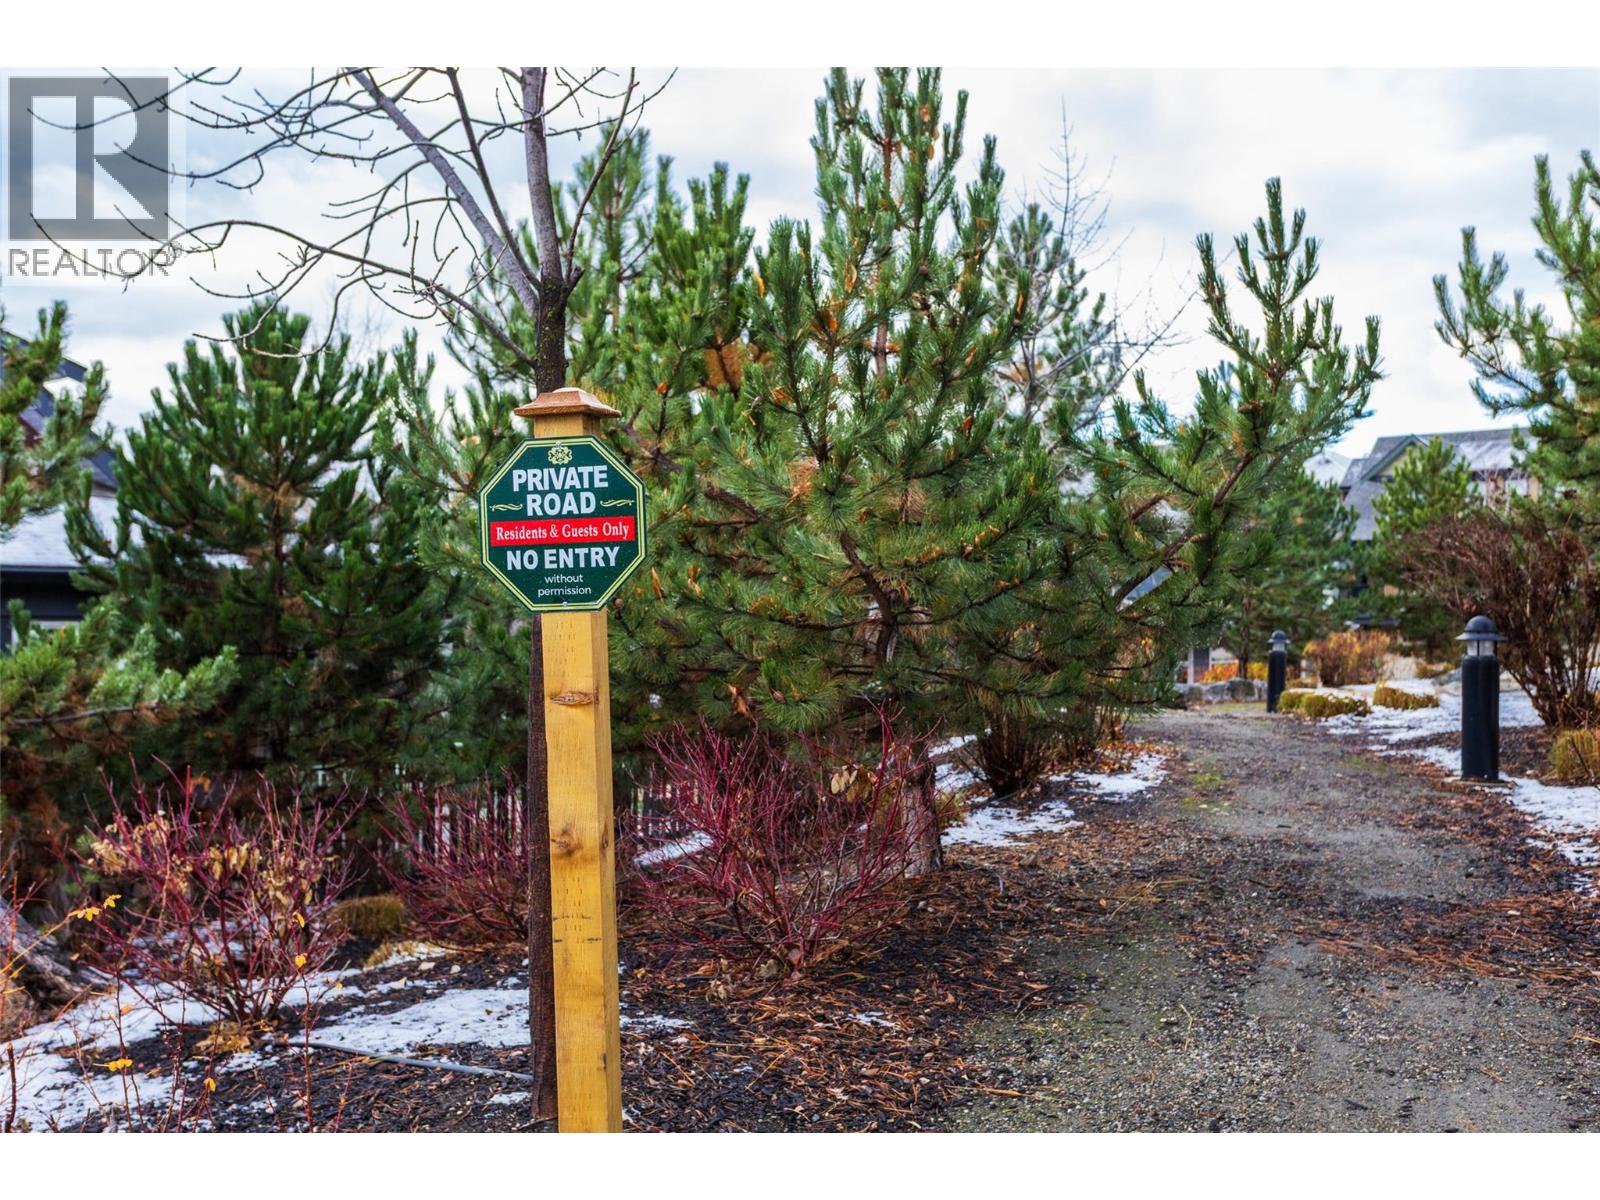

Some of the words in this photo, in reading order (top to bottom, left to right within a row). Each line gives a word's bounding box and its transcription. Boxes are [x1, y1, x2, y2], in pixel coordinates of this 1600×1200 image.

[512, 465, 609, 492] PRIVATE
[526, 491, 597, 517] ROAD
[496, 525, 547, 541] Residents
[550, 524, 559, 538] &
[561, 524, 598, 538] Guests
[602, 521, 630, 541] Only
[506, 549, 539, 571] NO
[544, 546, 620, 569] ENTRY
[544, 574, 584, 584] without
[537, 586, 592, 598] permission
